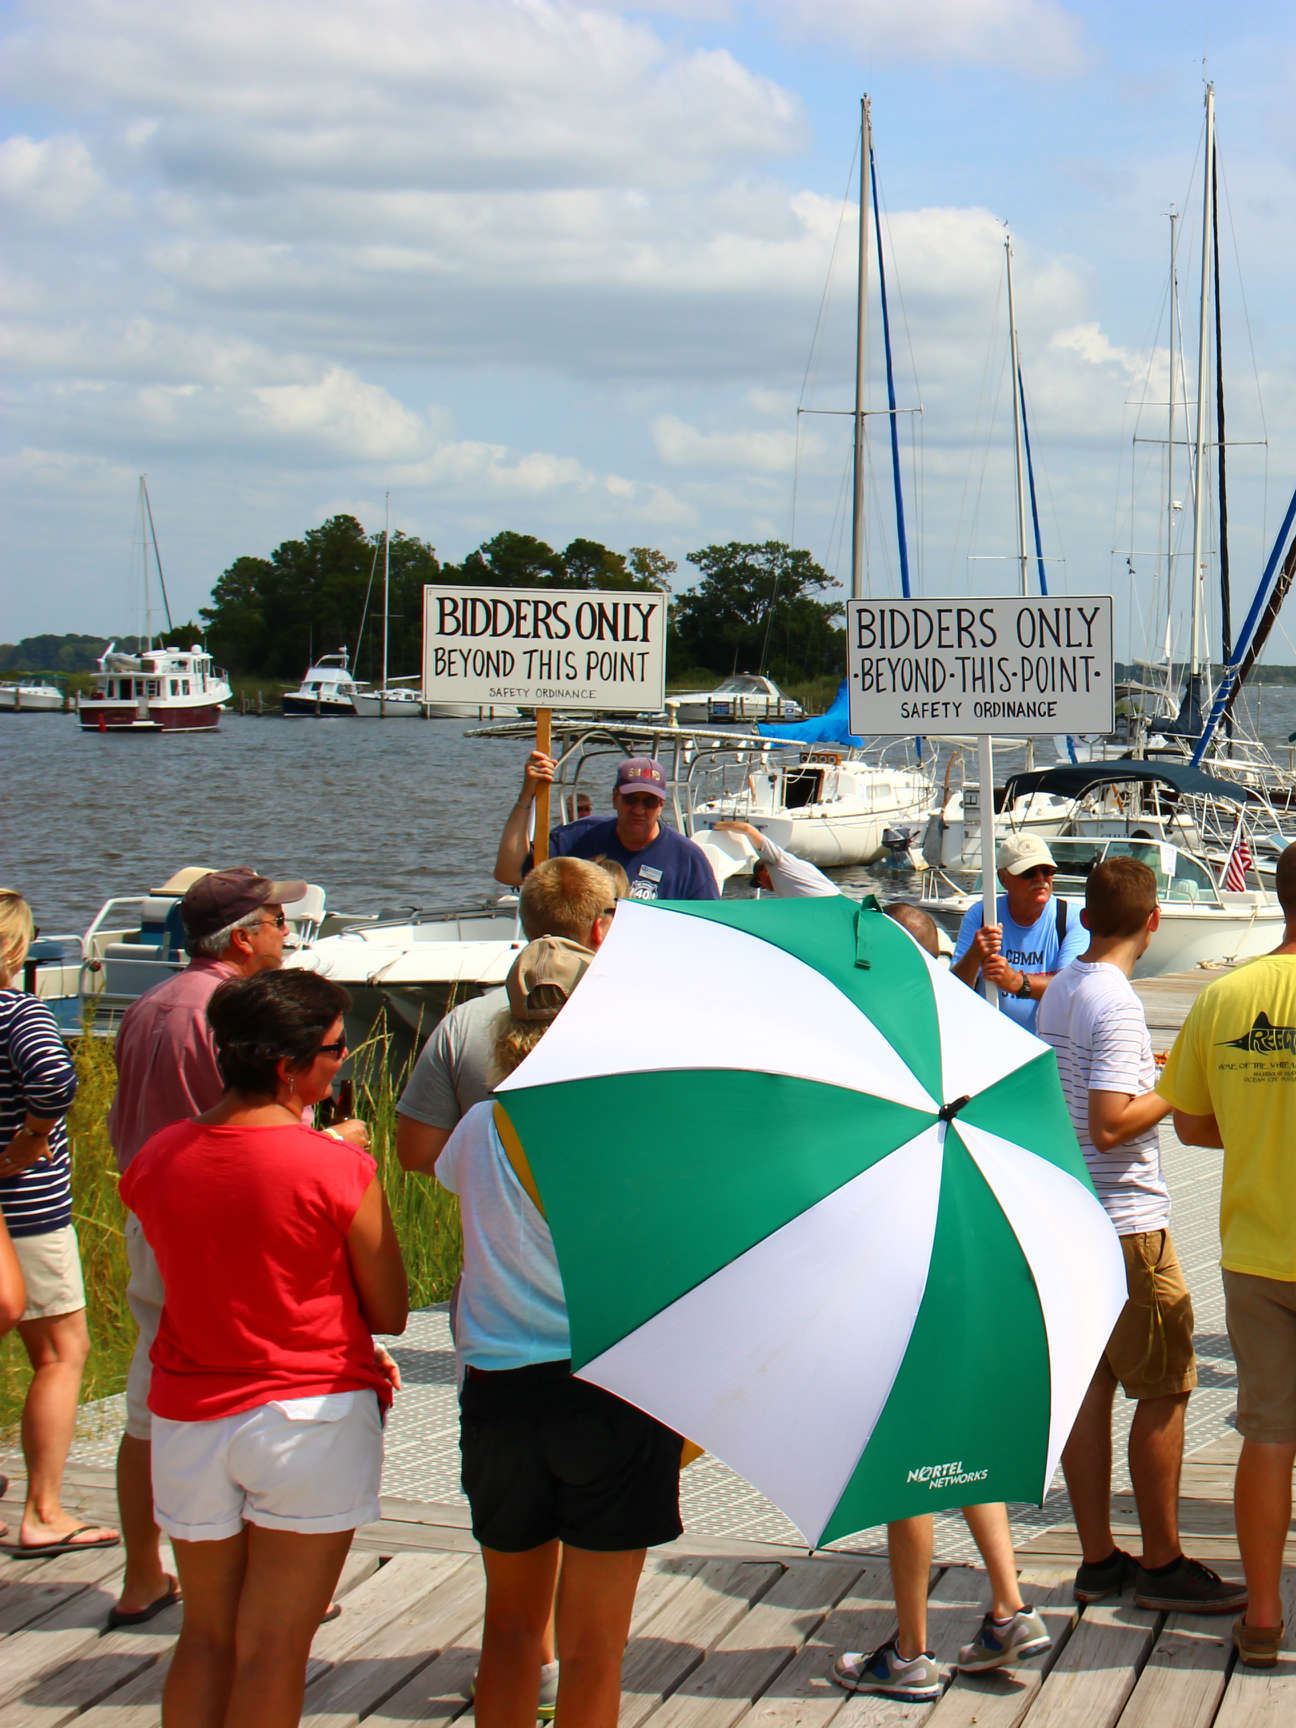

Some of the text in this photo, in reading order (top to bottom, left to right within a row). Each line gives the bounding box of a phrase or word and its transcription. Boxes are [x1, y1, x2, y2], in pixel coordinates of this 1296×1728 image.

[436, 597, 658, 642] BIDDERS ONLY
[856, 607, 1100, 649] BIDDERS ONLY
[434, 647, 650, 682] BEYOND THIS POINT
[489, 687, 597, 699] SAFETY ORDINANCE
[901, 701, 1058, 719] SAFETY ORDINANCE
[1006, 949, 1044, 965] CBMM
[906, 1461, 963, 1483] NORTEL
[929, 1469, 989, 1490] NETWORKS
